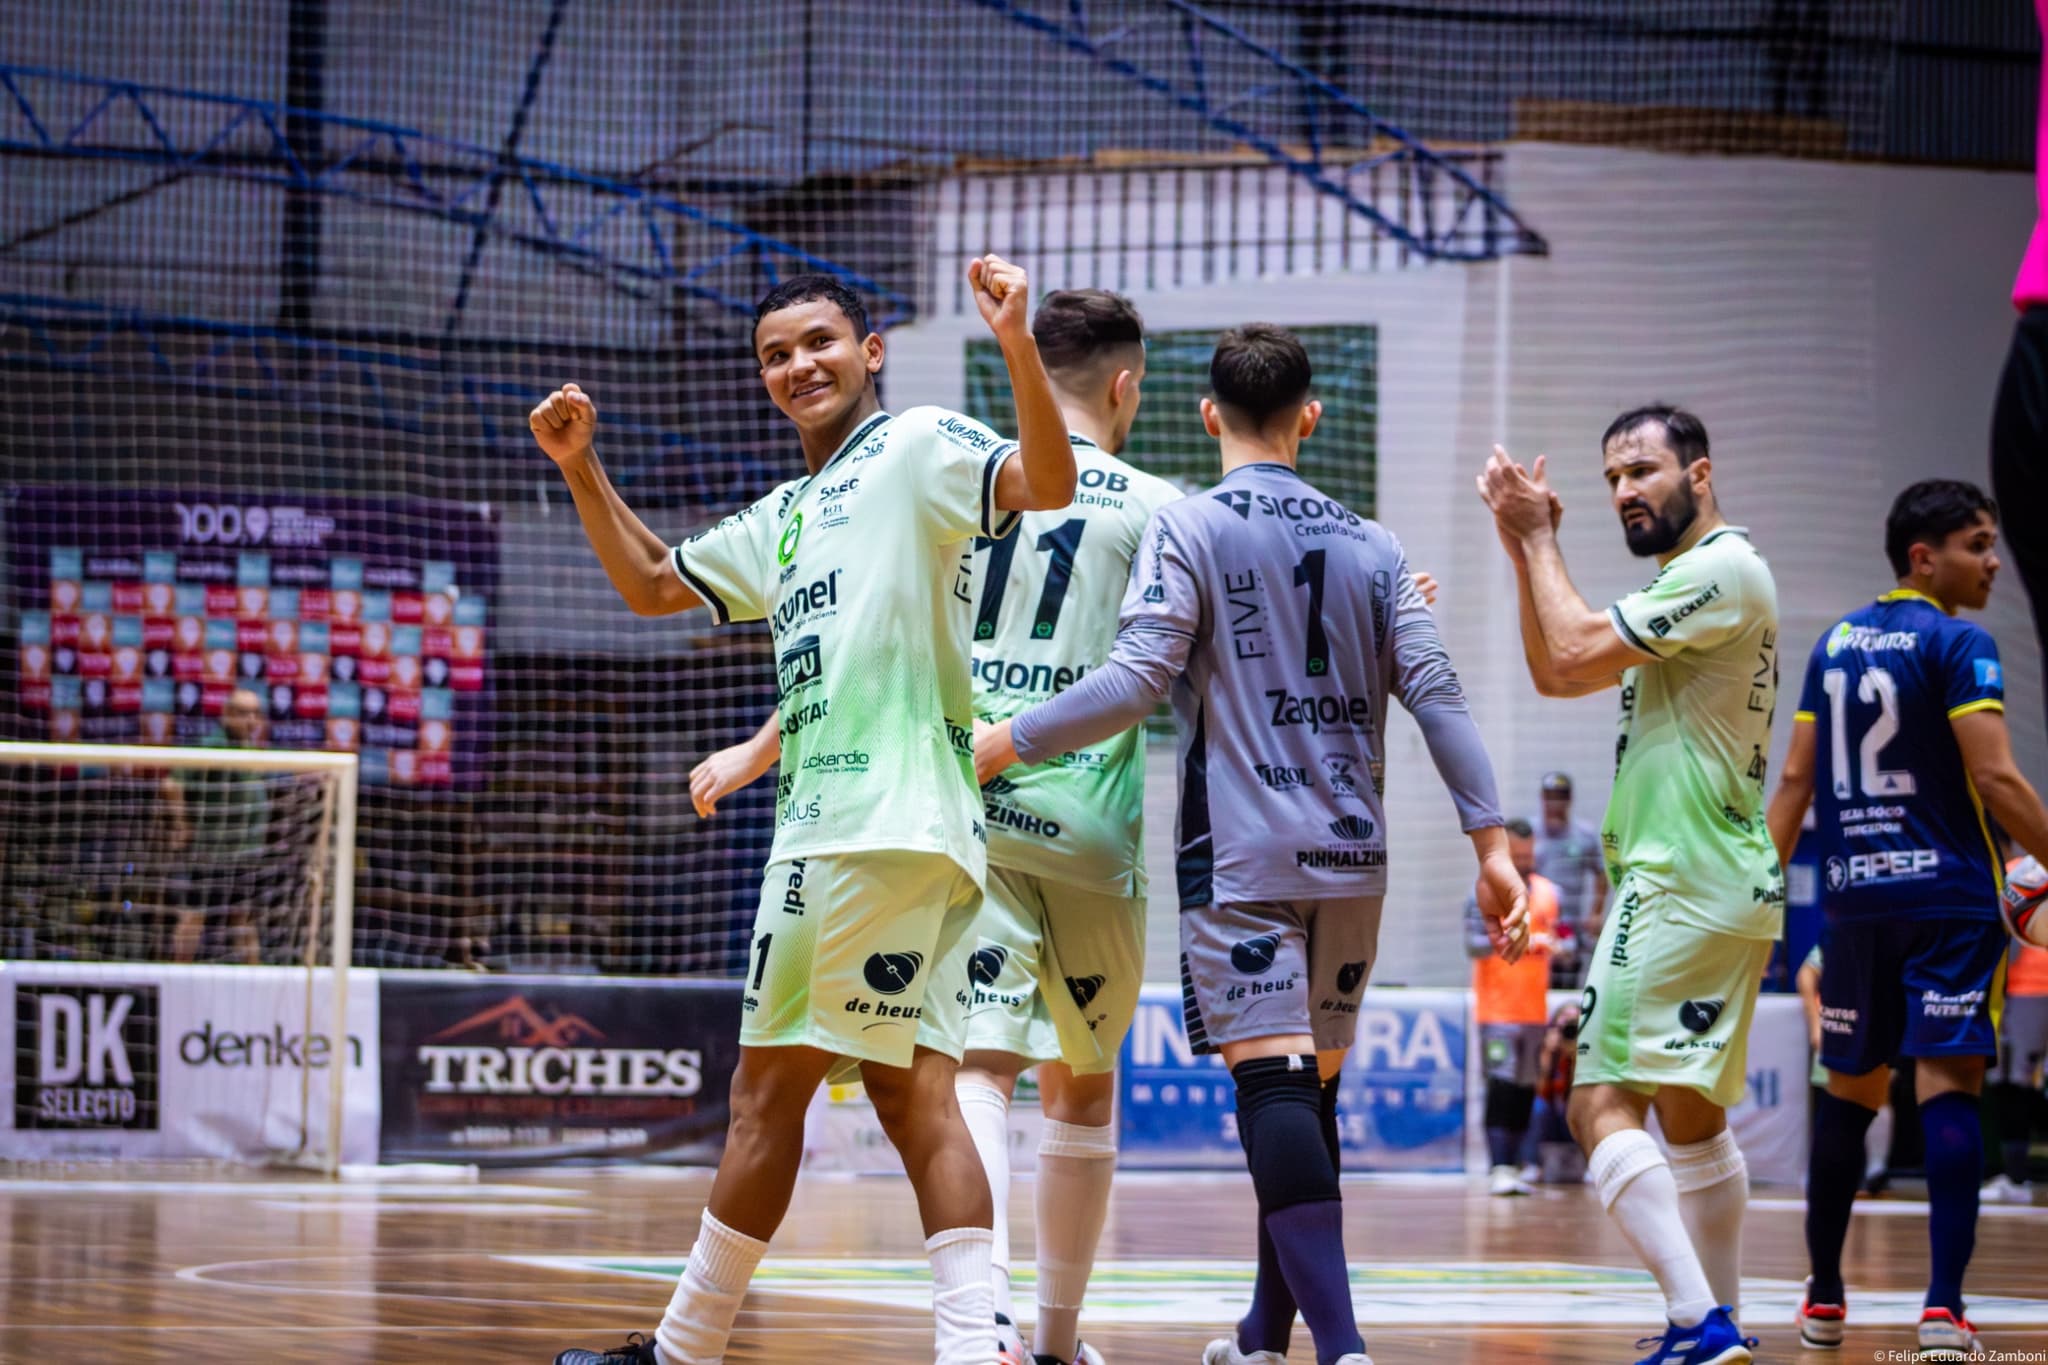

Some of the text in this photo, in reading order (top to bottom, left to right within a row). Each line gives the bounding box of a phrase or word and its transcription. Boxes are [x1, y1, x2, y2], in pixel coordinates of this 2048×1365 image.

[974, 515, 1087, 641] 11
[1671, 583, 1721, 623] ECKERT
[1224, 569, 1266, 660] FIVE
[1293, 549, 1330, 678] 1
[1747, 628, 1776, 712] FIVE
[1823, 667, 1918, 800] 12
[783, 857, 807, 917] redi
[1849, 849, 1940, 880] APEP
[1610, 890, 1640, 968] Sicredi
[845, 998, 871, 1015] de
[1227, 978, 1295, 1002] de heus
[39, 993, 136, 1085] DK
[178, 1020, 364, 1069] denken
[418, 1044, 703, 1096] TRICHES
[39, 1088, 136, 1121] SELECTO
